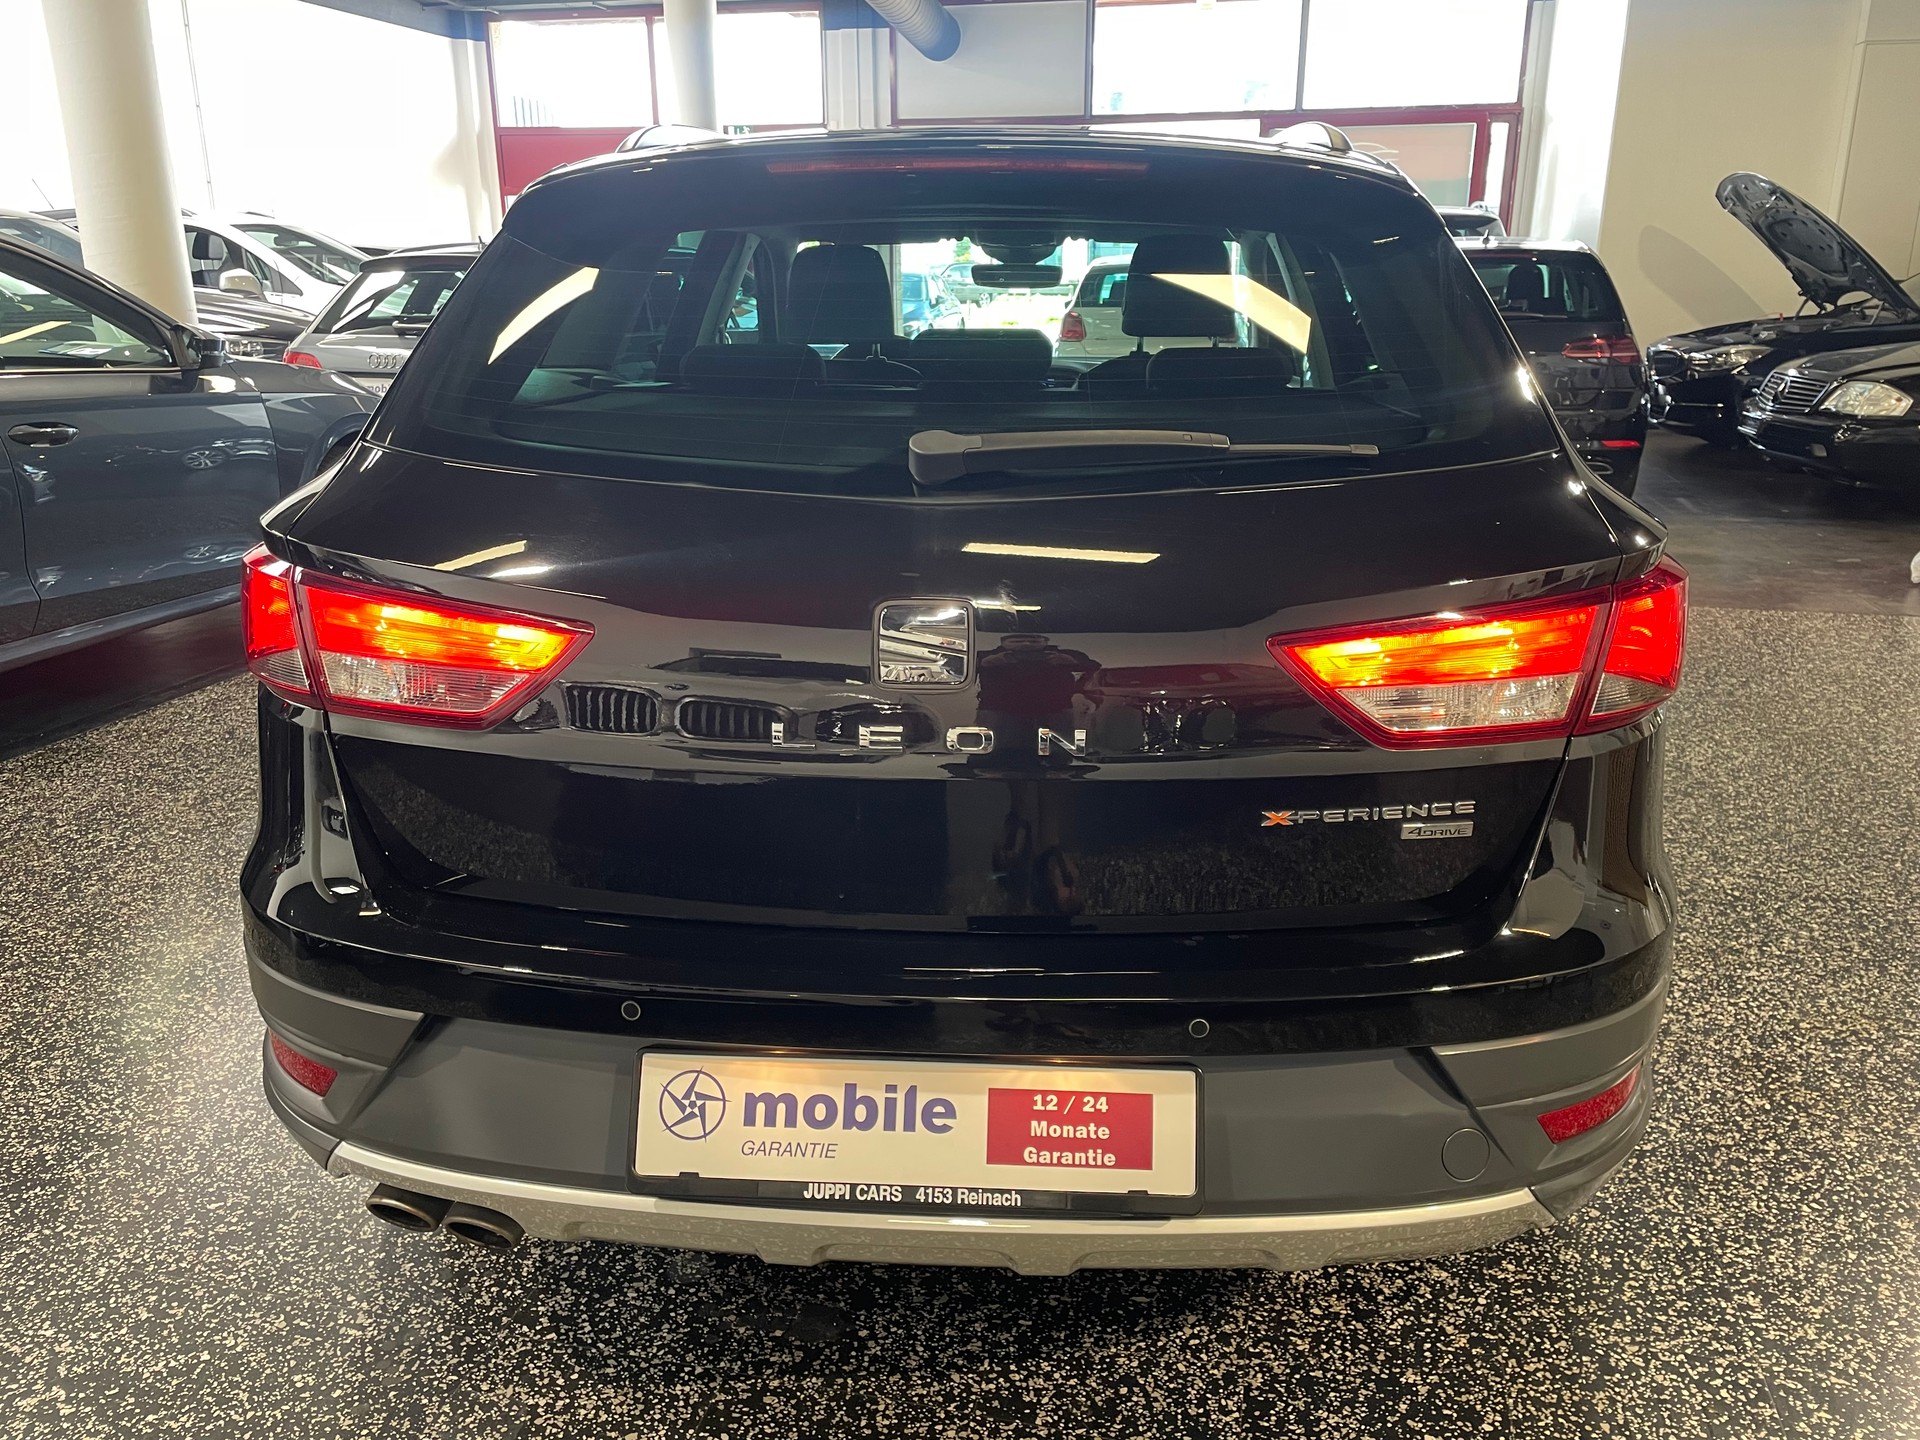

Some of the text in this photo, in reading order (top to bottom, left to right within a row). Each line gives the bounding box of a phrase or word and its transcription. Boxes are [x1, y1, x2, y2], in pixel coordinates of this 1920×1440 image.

[771, 722, 1087, 757] LEON
[1407, 827, 1469, 838] 4DRIVE
[742, 1082, 958, 1134] mobile
[1032, 1094, 1109, 1114] 12 / 24
[1030, 1120, 1111, 1140] Monate
[741, 1140, 838, 1160] GARANTIE
[1023, 1146, 1117, 1167] Garantie
[803, 1182, 1022, 1207] JUPPI CARS 4153 Reinach
